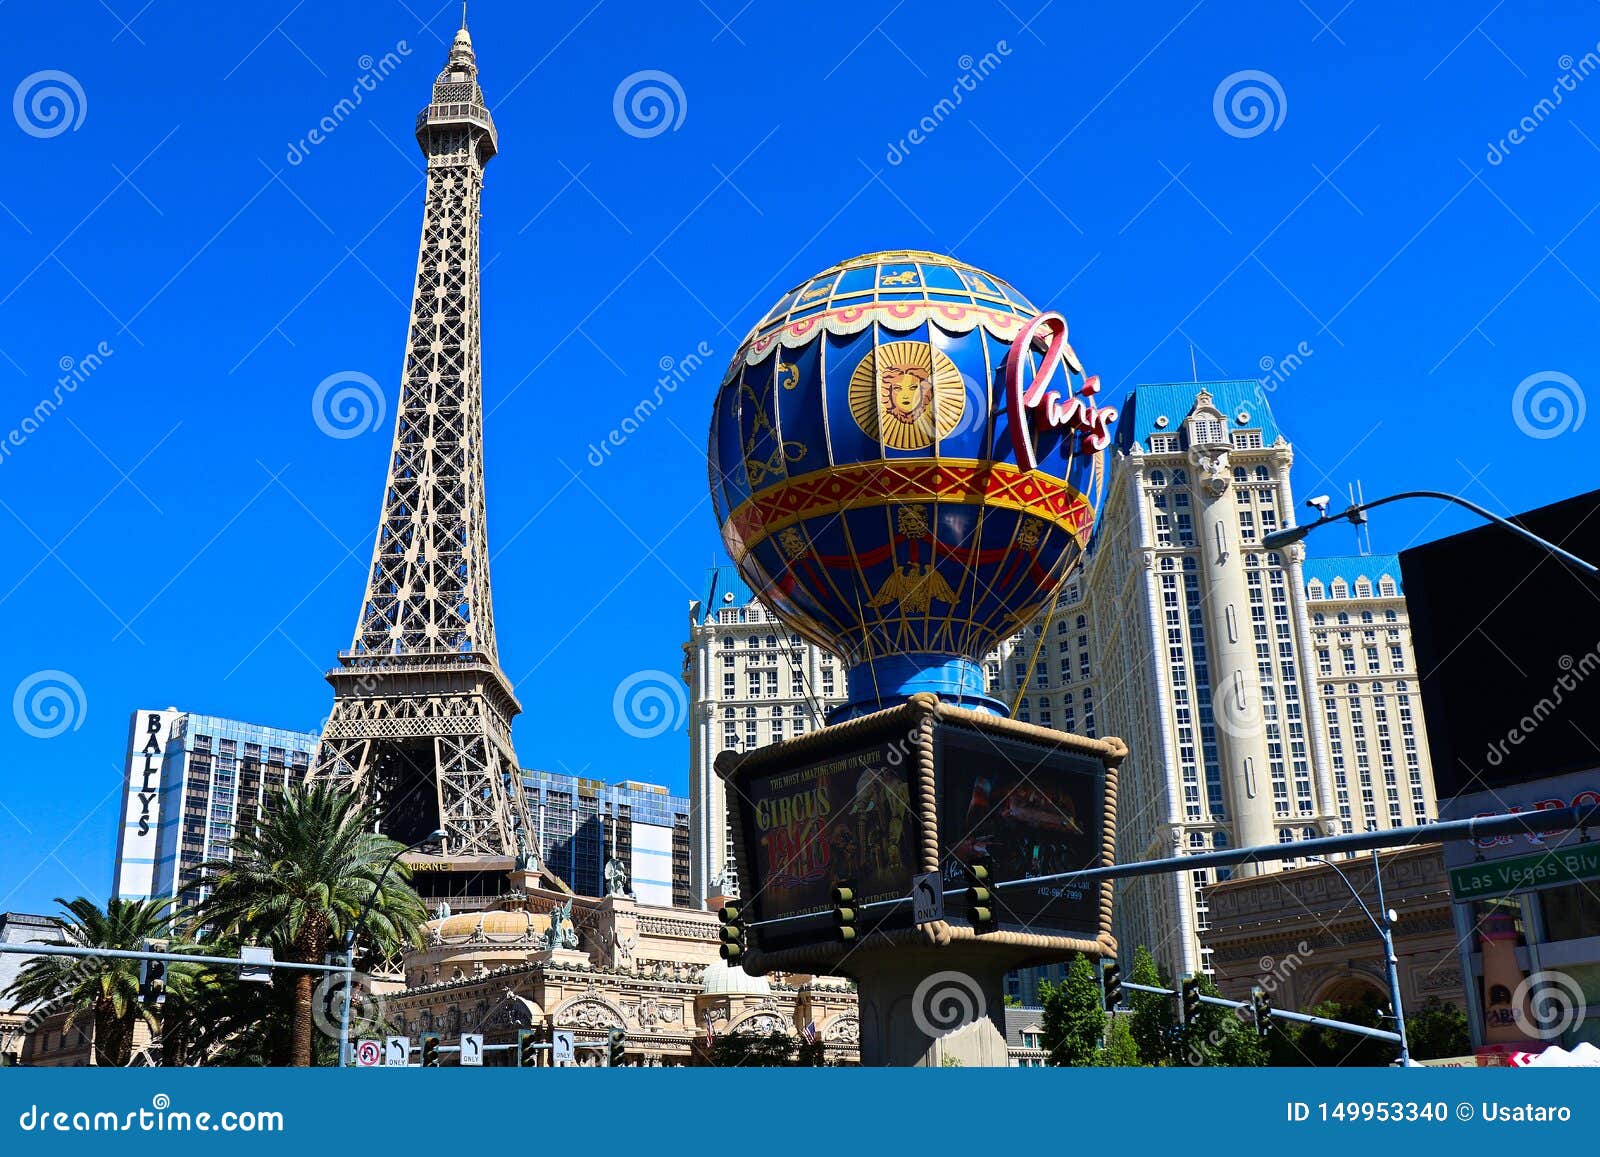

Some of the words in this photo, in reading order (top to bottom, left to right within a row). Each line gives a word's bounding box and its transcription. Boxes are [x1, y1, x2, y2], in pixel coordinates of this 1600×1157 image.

[1006, 311, 1118, 473] Paris
[138, 713, 162, 837] BALLYS
[770, 778, 783, 793] THE
[783, 773, 800, 788] MOST
[800, 764, 829, 784] AMAZING
[829, 759, 847, 775] SHOW
[848, 757, 859, 769] ON
[858, 750, 881, 767] EARTH
[755, 784, 831, 835] CIRCUS
[1458, 873, 1493, 891] Las
[1498, 862, 1558, 885] Vegas
[917, 908, 938, 920] ONLY
[463, 1055, 480, 1063] ONLY
[556, 1051, 571, 1060] ONLY
